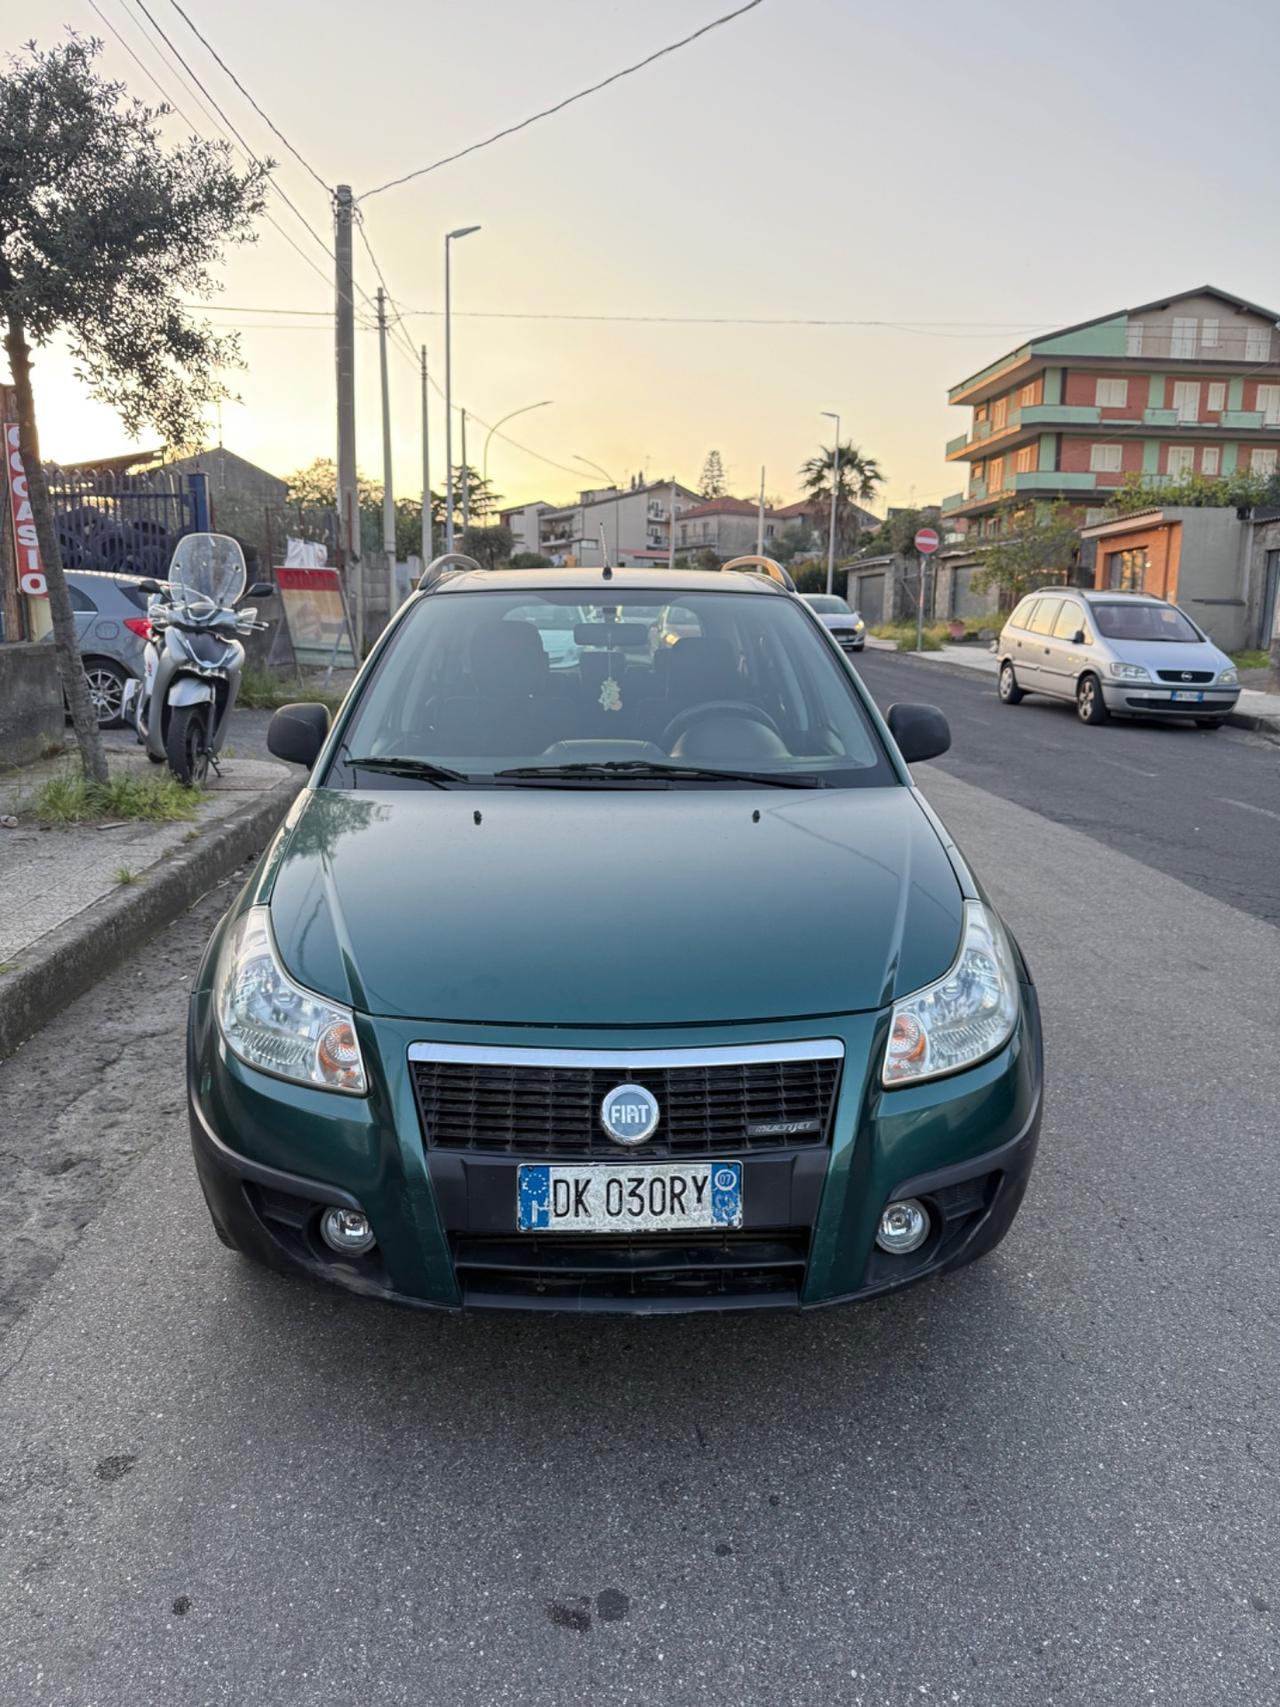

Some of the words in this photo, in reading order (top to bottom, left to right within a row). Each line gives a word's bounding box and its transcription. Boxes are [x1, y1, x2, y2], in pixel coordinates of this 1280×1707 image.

[611, 1105, 649, 1124] FIAT
[719, 1174, 732, 1186] 07
[553, 1179, 591, 1218] DK
[606, 1175, 709, 1217] 030RY
